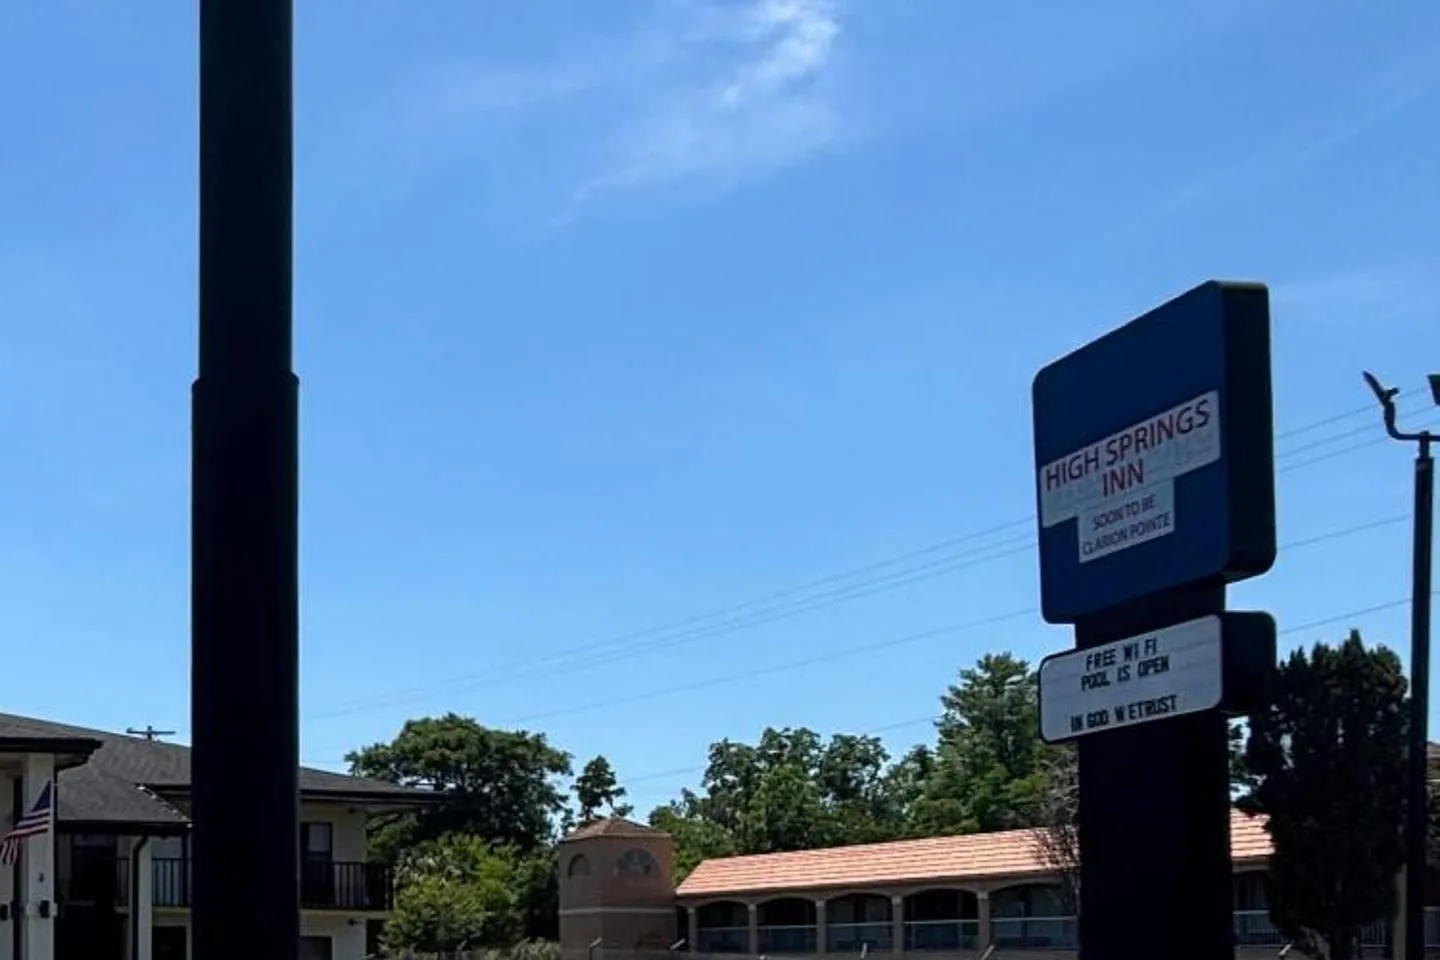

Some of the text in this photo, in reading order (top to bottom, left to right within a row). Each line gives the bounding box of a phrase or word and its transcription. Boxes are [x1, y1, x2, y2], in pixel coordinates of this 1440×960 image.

[1045, 399, 1210, 492] HIGH SPRINGS
[1101, 459, 1144, 497] INN
[1093, 494, 1157, 531] SOON TO BE
[1082, 511, 1172, 555] CLARION POINTE
[1080, 654, 1170, 691] POOL IS OPEN
[1086, 637, 1157, 672] FREE WI FI
[1070, 713, 1083, 732] IN
[1086, 709, 1109, 728] GOD
